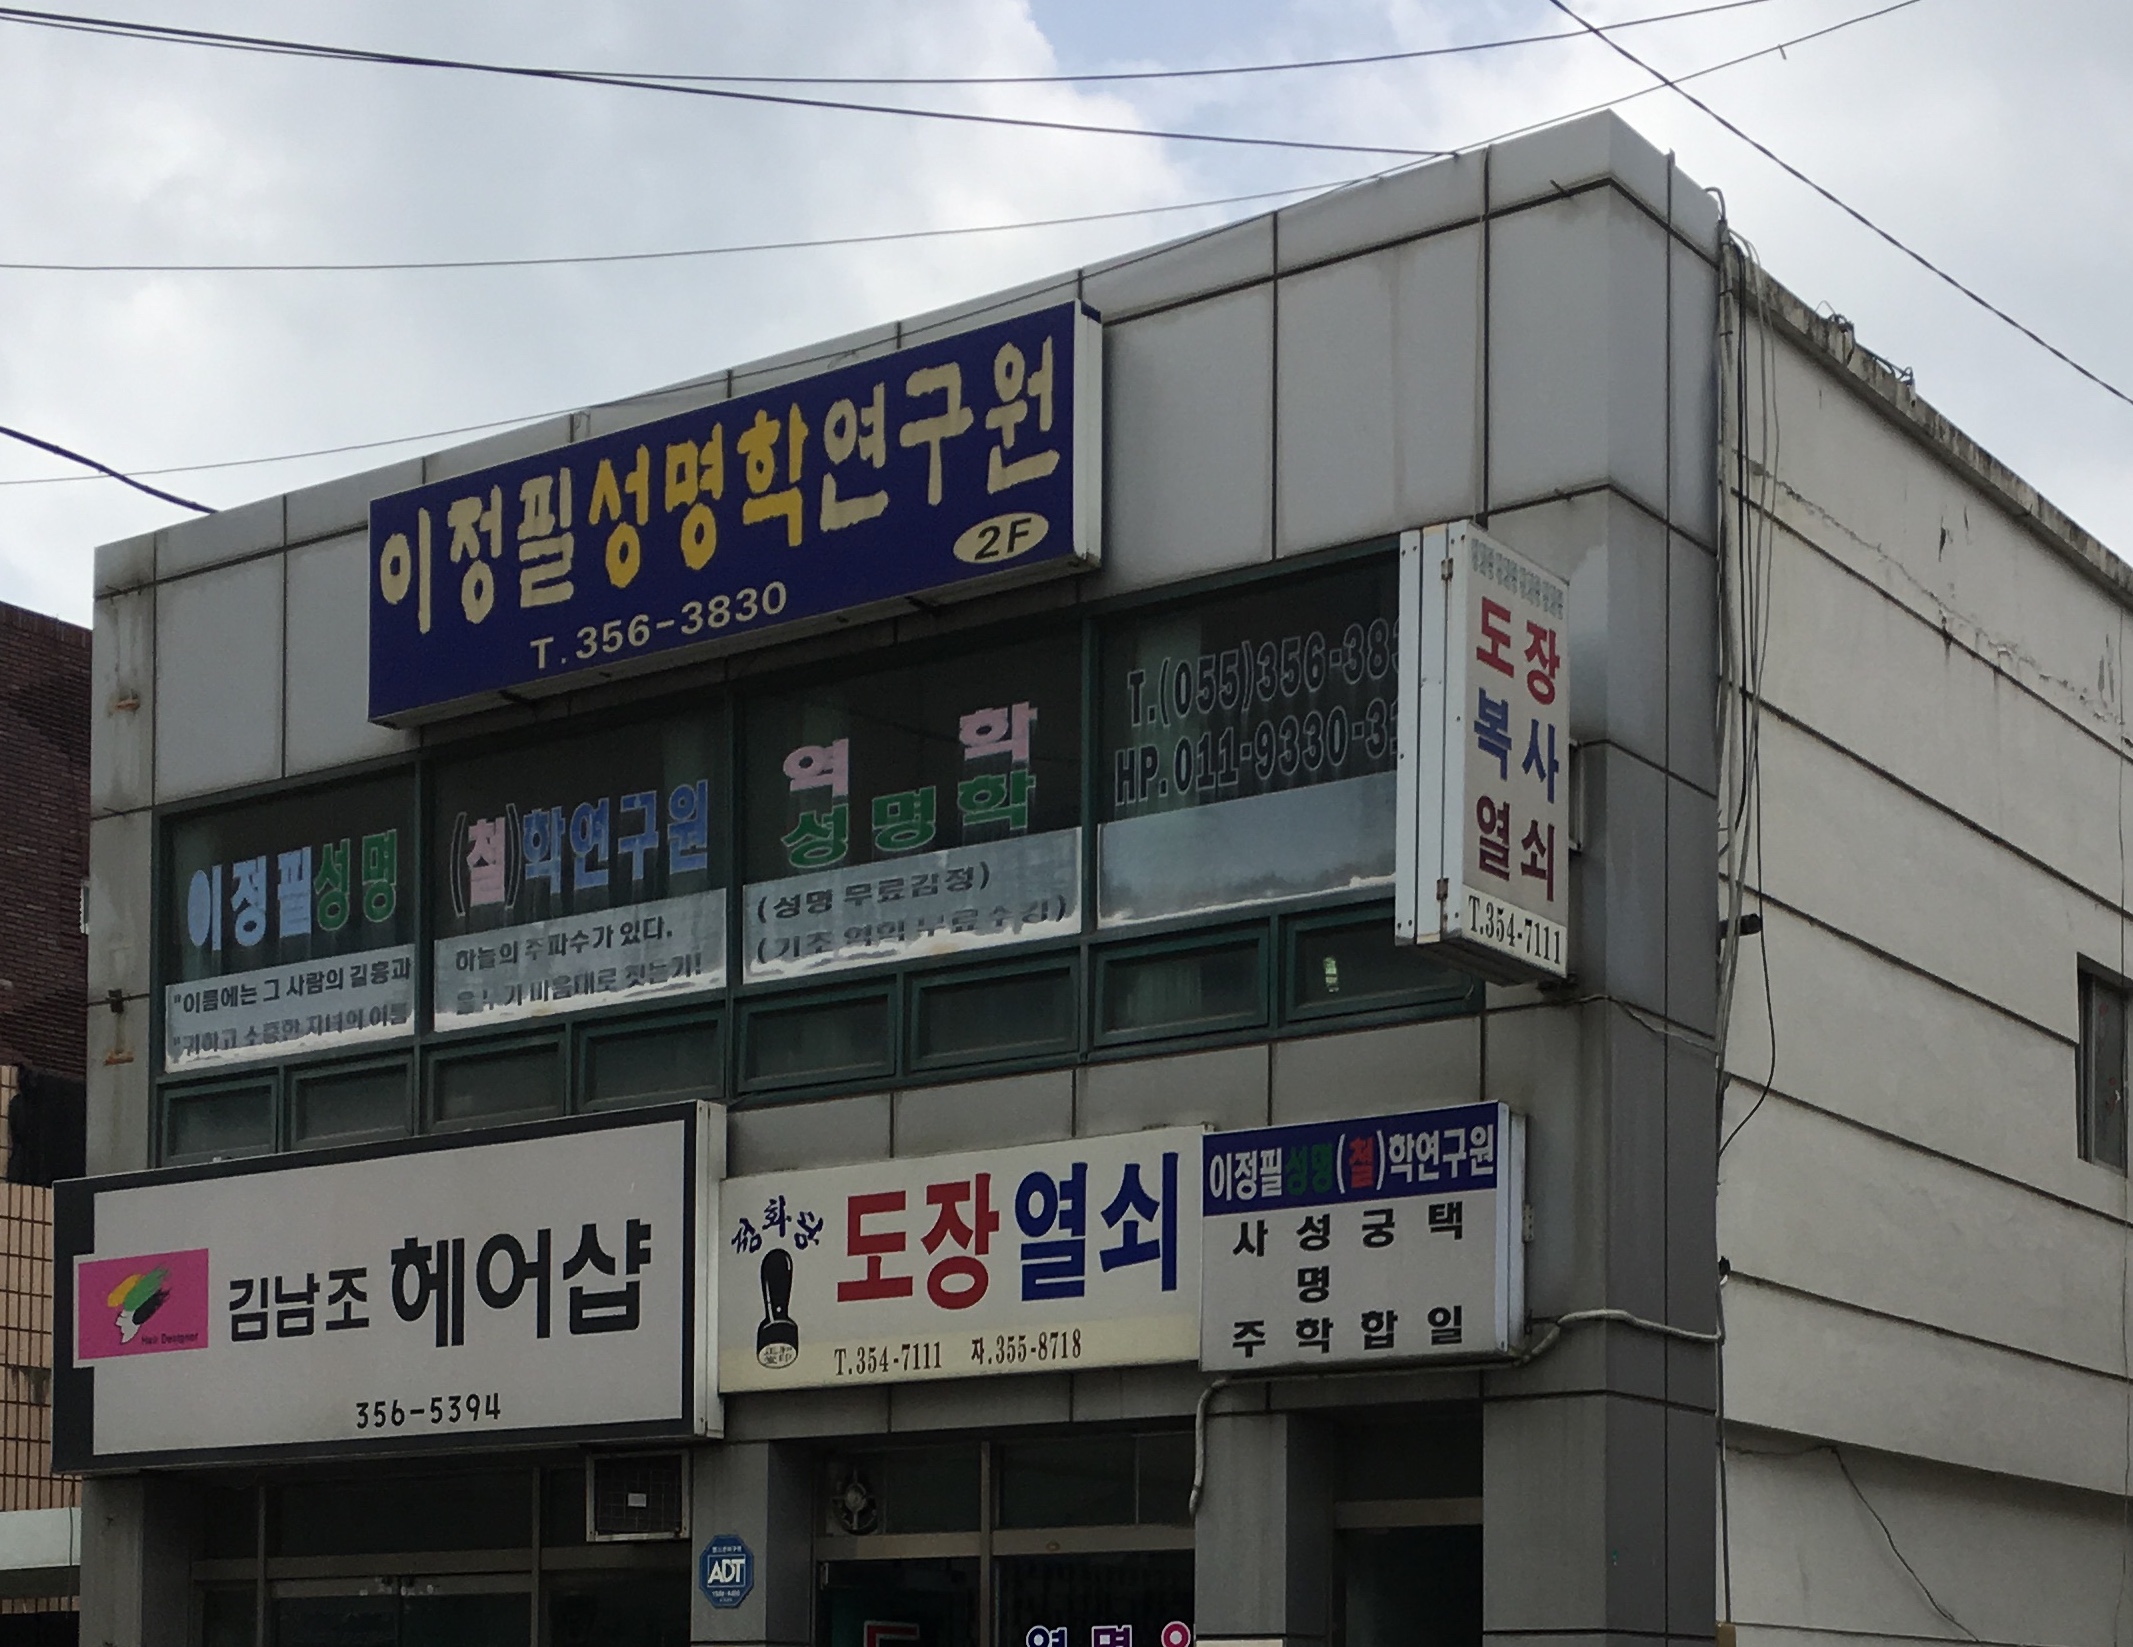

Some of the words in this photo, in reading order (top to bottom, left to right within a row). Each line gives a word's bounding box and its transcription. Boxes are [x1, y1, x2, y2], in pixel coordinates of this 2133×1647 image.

[974, 517, 1034, 562] 2F
[1476, 595, 1560, 706] 도장
[1474, 687, 1559, 803] 복사
[1476, 795, 1555, 902] 열쇠
[456, 940, 518, 972] 하늘의
[620, 916, 673, 946] 있다.
[263, 979, 280, 1002] 그
[286, 967, 344, 997] 사람의
[350, 957, 411, 989] 길흉과
[229, 1266, 370, 1342] 김남조
[390, 1218, 652, 1348] 헤어샵
[834, 1341, 943, 1376] T.354-7111
[356, 1392, 501, 1430] 356-5394
[707, 1558, 746, 1584] ADT
